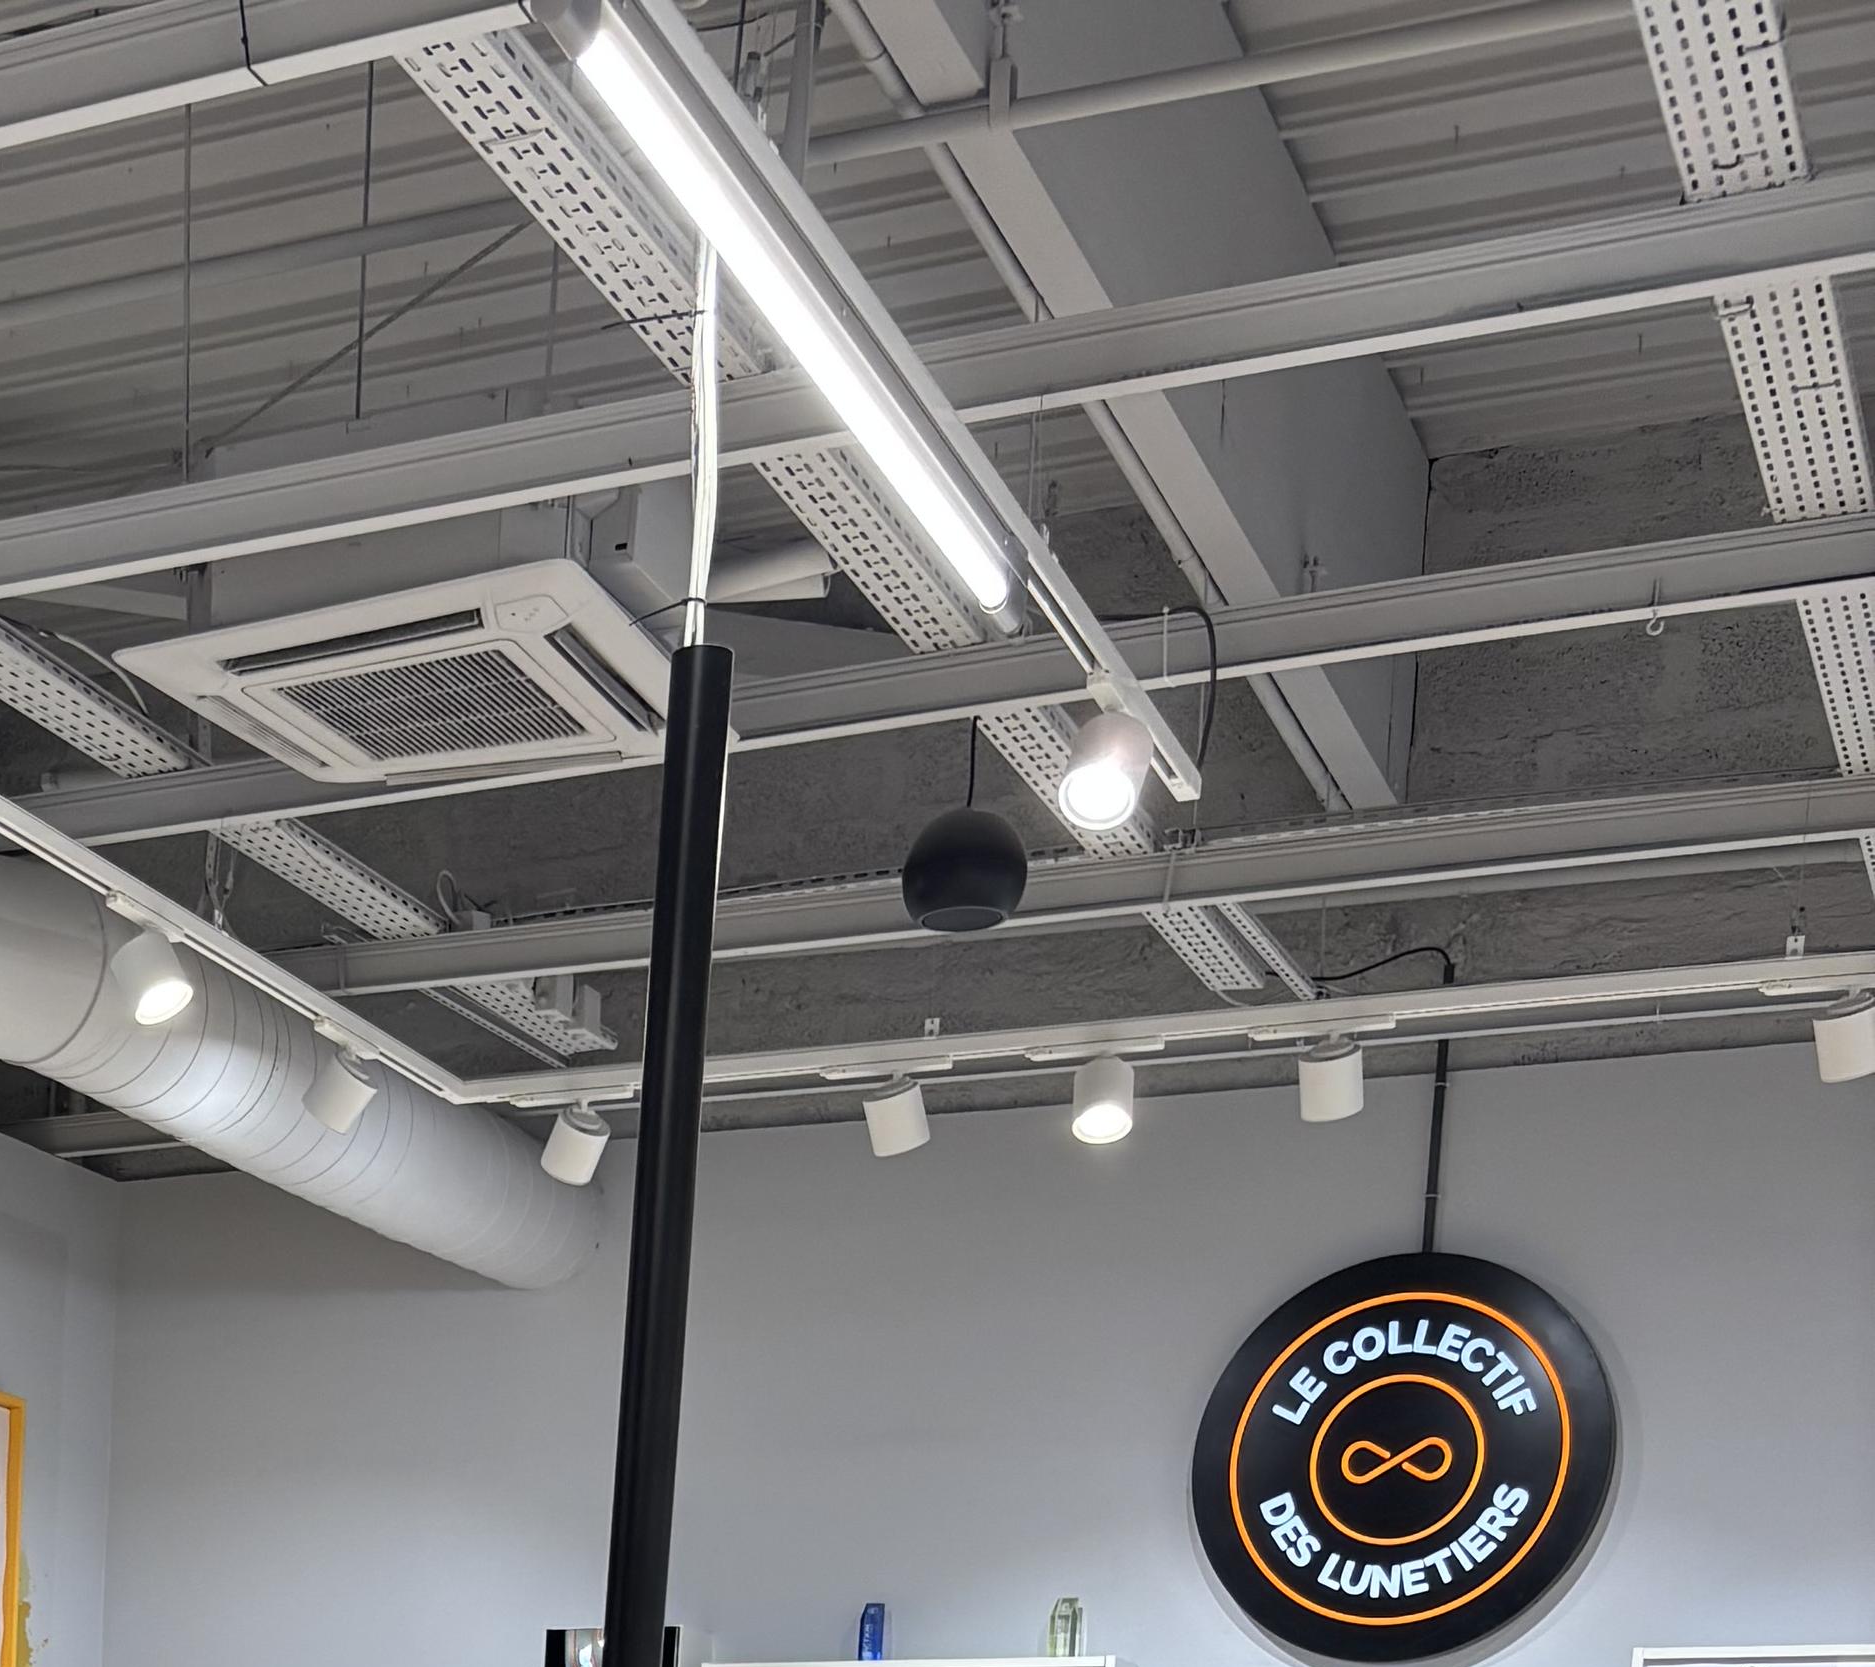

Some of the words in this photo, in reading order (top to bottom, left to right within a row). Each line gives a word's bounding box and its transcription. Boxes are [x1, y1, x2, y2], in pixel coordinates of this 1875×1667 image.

[1272, 1366, 1327, 1425] LE
[1323, 1319, 1537, 1416] COLLECTIF
[1259, 1492, 1321, 1568] DES
[1317, 1482, 1530, 1599] LUNETIERS
